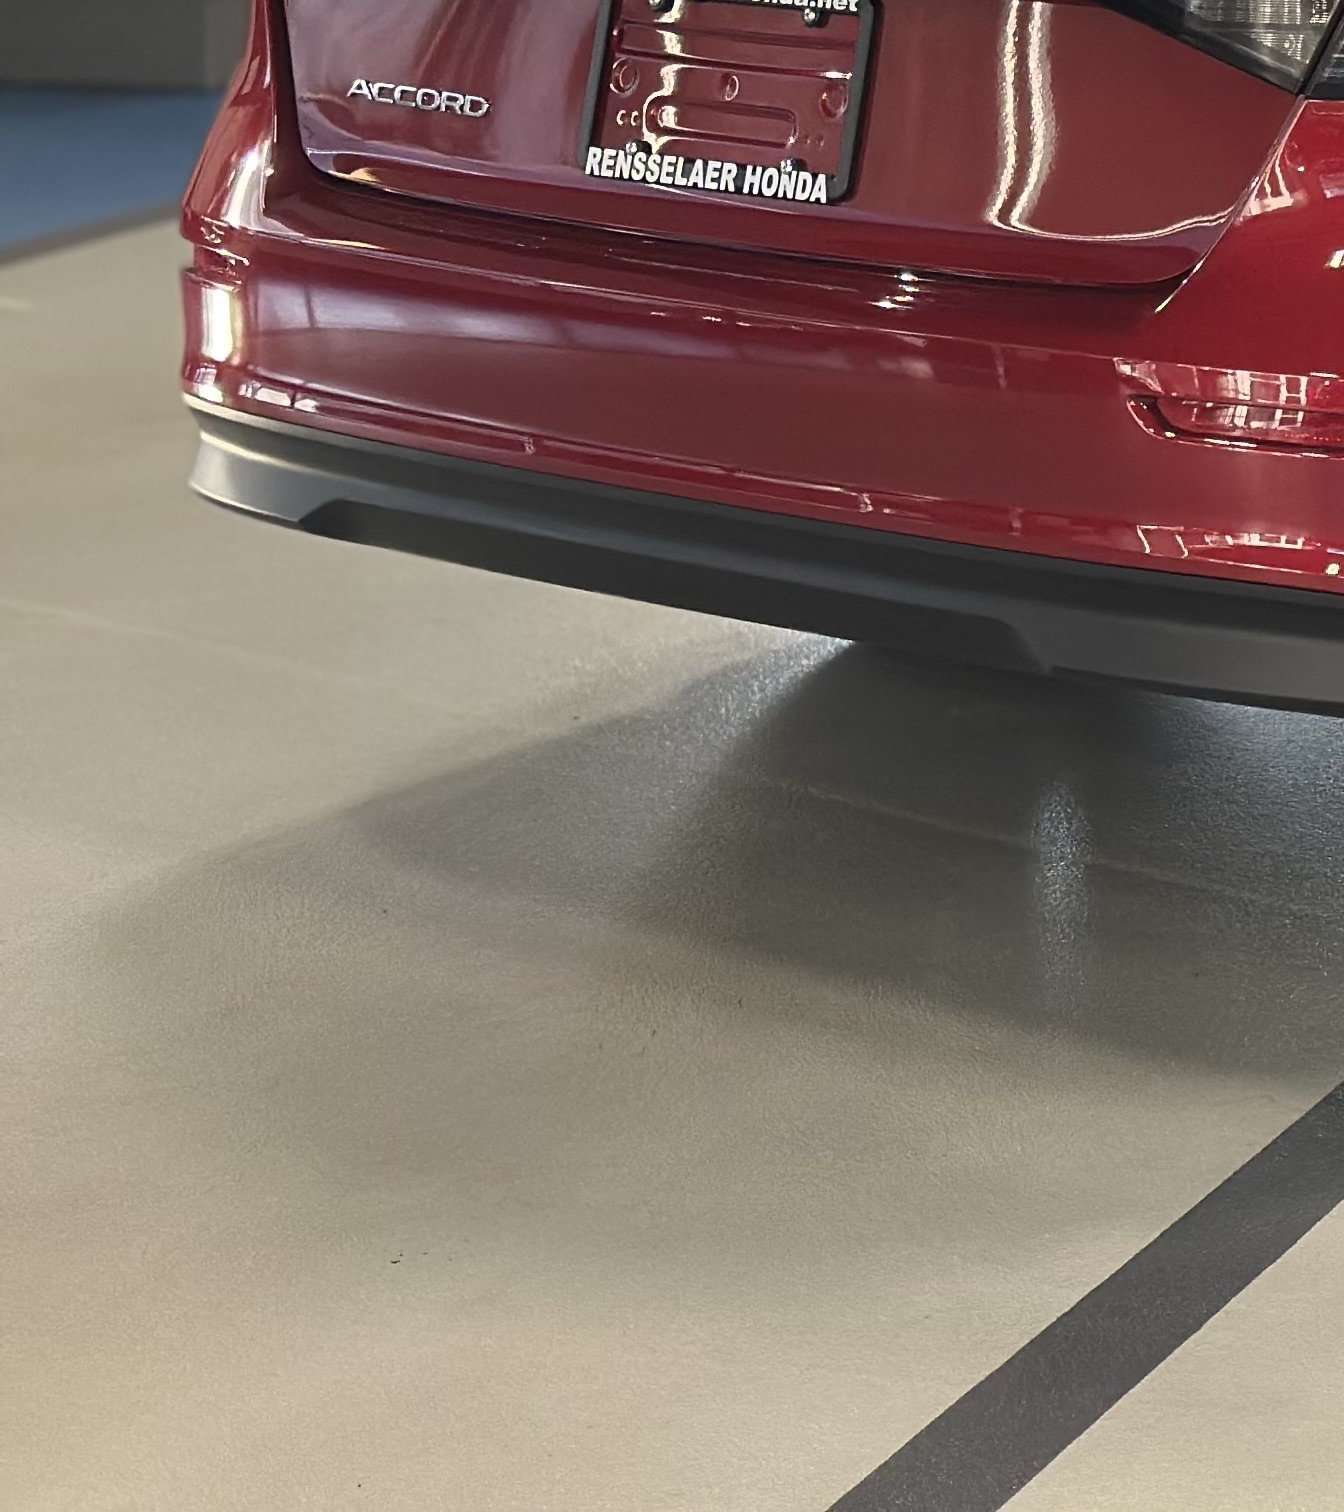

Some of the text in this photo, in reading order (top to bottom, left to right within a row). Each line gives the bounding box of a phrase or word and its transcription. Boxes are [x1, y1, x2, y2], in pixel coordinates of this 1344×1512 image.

[346, 78, 491, 117] ACCORD
[585, 146, 827, 203] RENSSELAER HONDA
